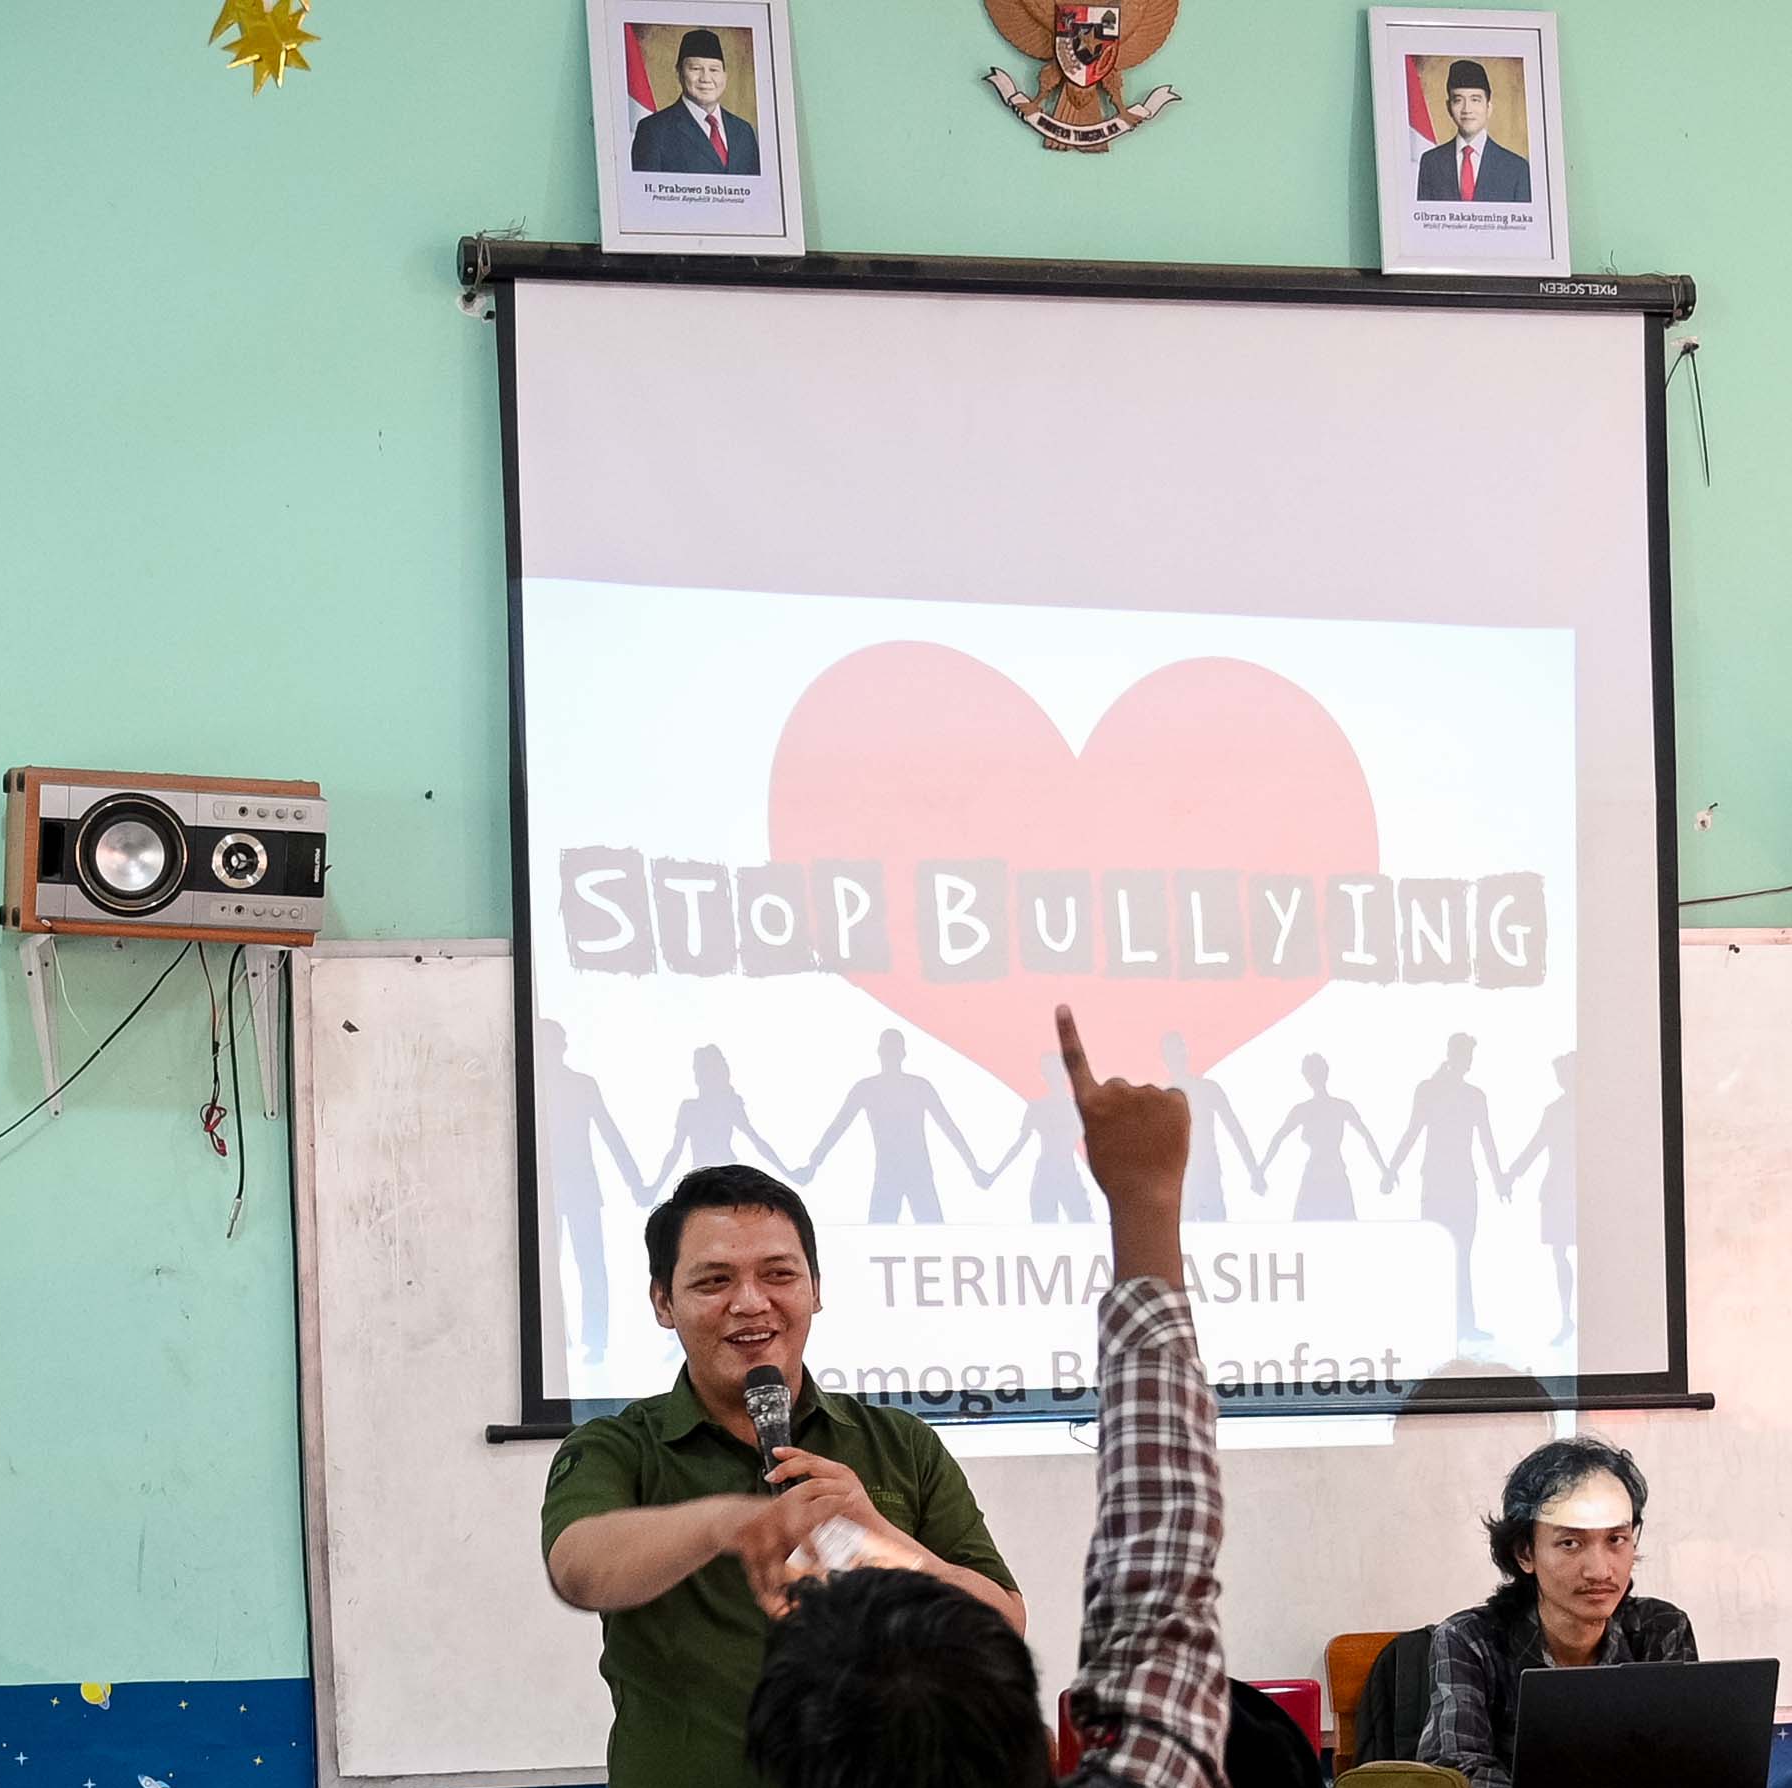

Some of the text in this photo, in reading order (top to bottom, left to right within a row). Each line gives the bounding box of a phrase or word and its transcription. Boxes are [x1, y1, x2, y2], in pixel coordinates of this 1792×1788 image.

[658, 184, 702, 194] Prabowo
[704, 186, 751, 196] Subianto
[1413, 212, 1534, 225] Gibran Rakabuming Raka
[1539, 282, 1618, 296] PIXELSCREEN
[573, 865, 1535, 970] STOP BULLYING
[869, 1252, 1307, 1309] TERIMA ASIH
[817, 1362, 1028, 1413] emoga
